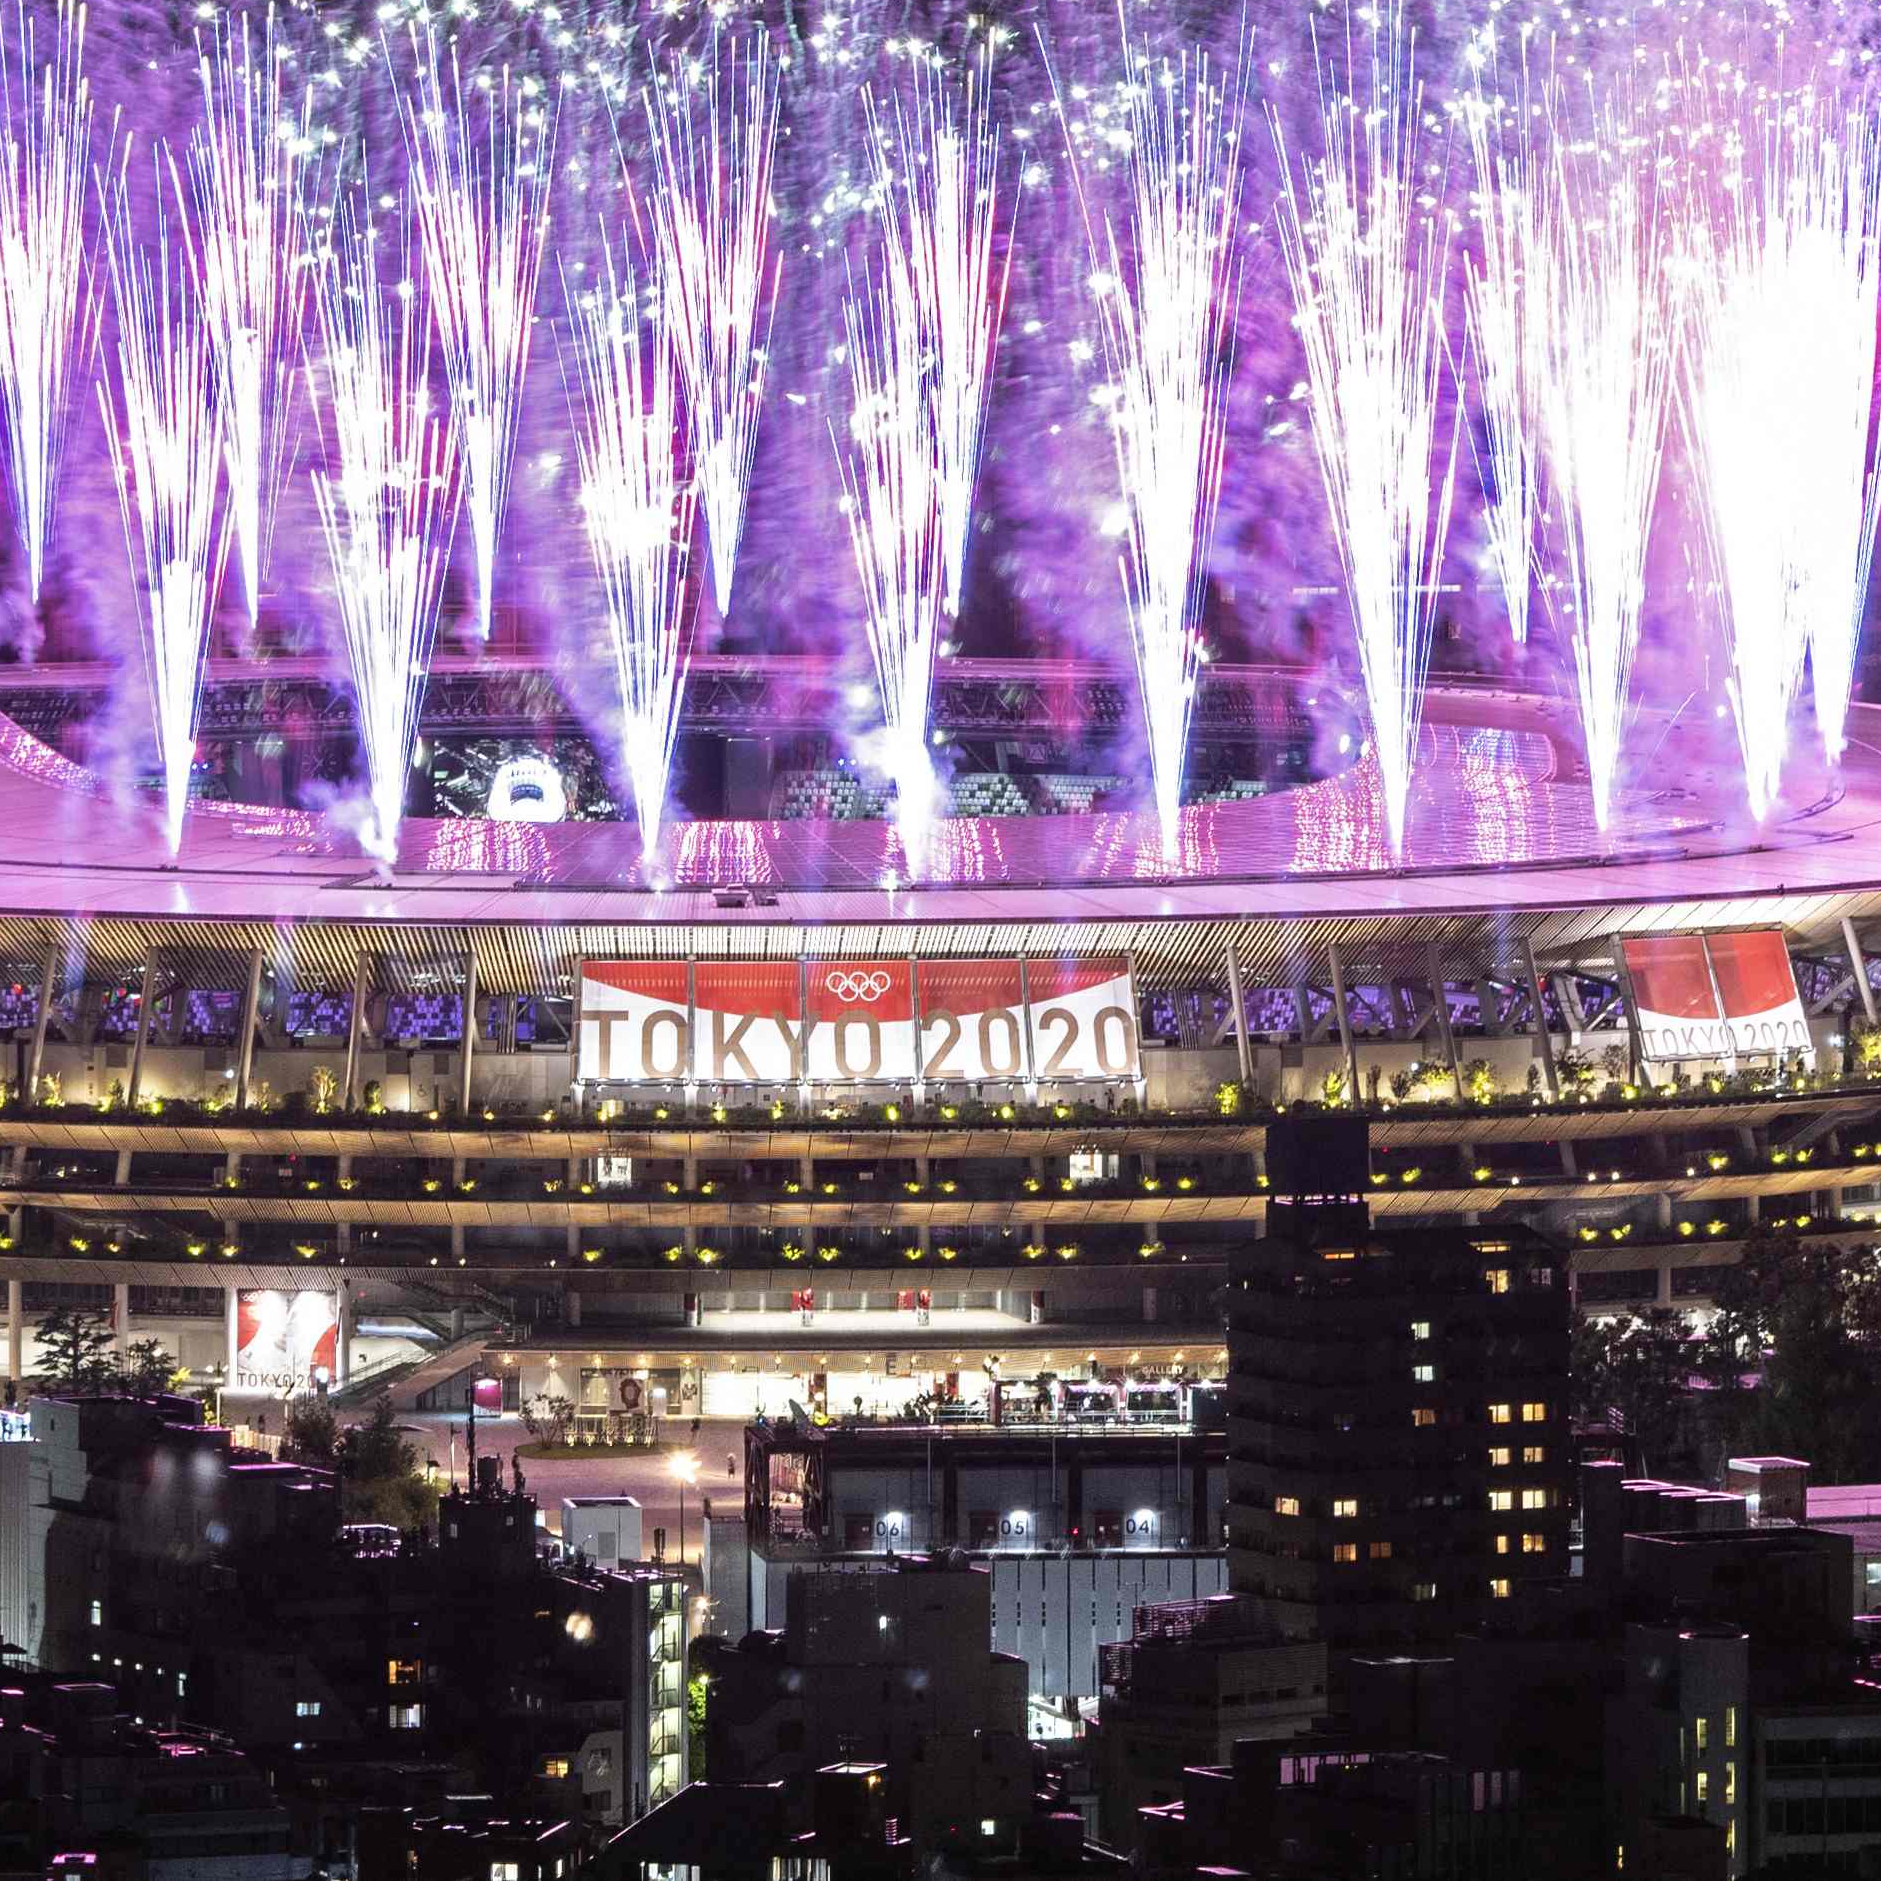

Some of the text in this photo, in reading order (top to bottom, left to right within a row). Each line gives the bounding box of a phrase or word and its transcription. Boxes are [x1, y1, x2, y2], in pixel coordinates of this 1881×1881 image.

[582, 1005, 1135, 1079] TOKYO 2020
[1644, 1020, 1807, 1055] TOKYO 2020
[237, 1373, 292, 1388] TOKYO
[876, 1521, 900, 1536] 06
[1000, 1519, 1025, 1535] 05
[1125, 1519, 1150, 1534] 04
